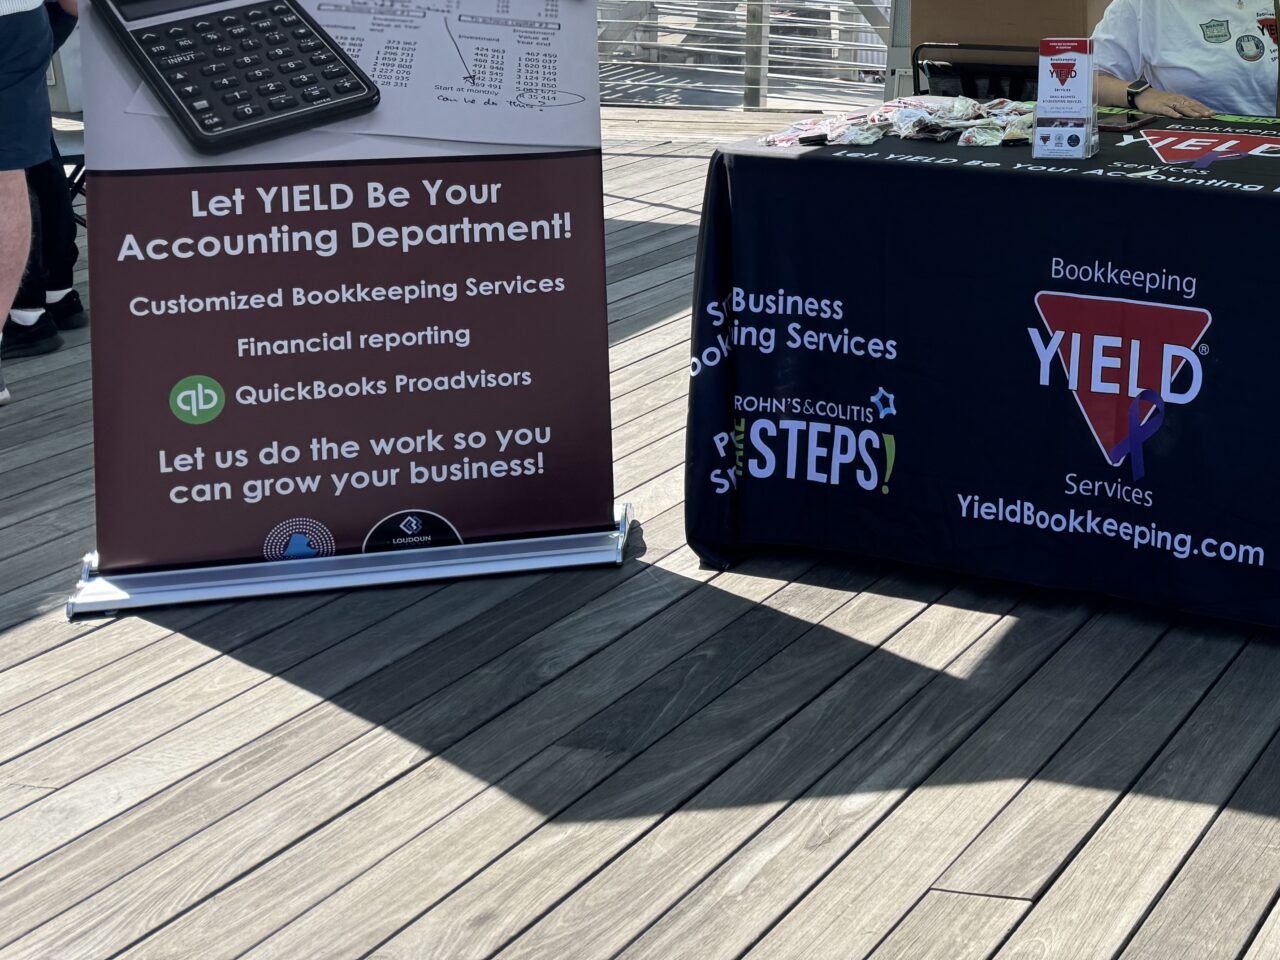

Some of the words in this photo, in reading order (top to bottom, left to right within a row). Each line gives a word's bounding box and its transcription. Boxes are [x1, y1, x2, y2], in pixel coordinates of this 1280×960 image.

[167, 54, 195, 65] INPUT
[832, 150, 879, 159] Let
[884, 153, 958, 164] YIELD
[962, 159, 1001, 168] Be
[1013, 162, 1081, 175] Your
[1108, 161, 1211, 175] Services
[191, 189, 245, 218] Let
[256, 183, 354, 214] YIELD
[367, 181, 411, 209] Be
[422, 178, 502, 205] Your
[117, 224, 338, 262] Accounting
[351, 212, 572, 253] Department!
[129, 288, 284, 317] Customized
[291, 278, 458, 308] Bookkeeping
[465, 274, 566, 297] Services
[1051, 257, 1196, 299] Bookkeeping
[732, 286, 844, 321] Business
[236, 330, 352, 358] Financial
[359, 326, 471, 354] reporting
[786, 322, 898, 361] Services
[1027, 327, 1203, 404] YIELD
[235, 377, 387, 406] QuickBooks
[395, 368, 532, 394] Proadvisors
[159, 450, 205, 474] Let
[215, 449, 248, 469] us
[259, 440, 300, 466] do
[310, 435, 360, 462] the
[370, 429, 445, 456] work
[453, 426, 487, 449] so
[496, 424, 552, 453] you
[748, 419, 896, 495] STEPS!
[169, 478, 232, 504] can
[243, 474, 322, 503] grow
[331, 469, 400, 497] your
[410, 451, 545, 485] business!
[1065, 473, 1153, 507] Services
[393, 535, 432, 545] LOUDOUN
[957, 493, 1265, 566] YieldBookkeeping.com
